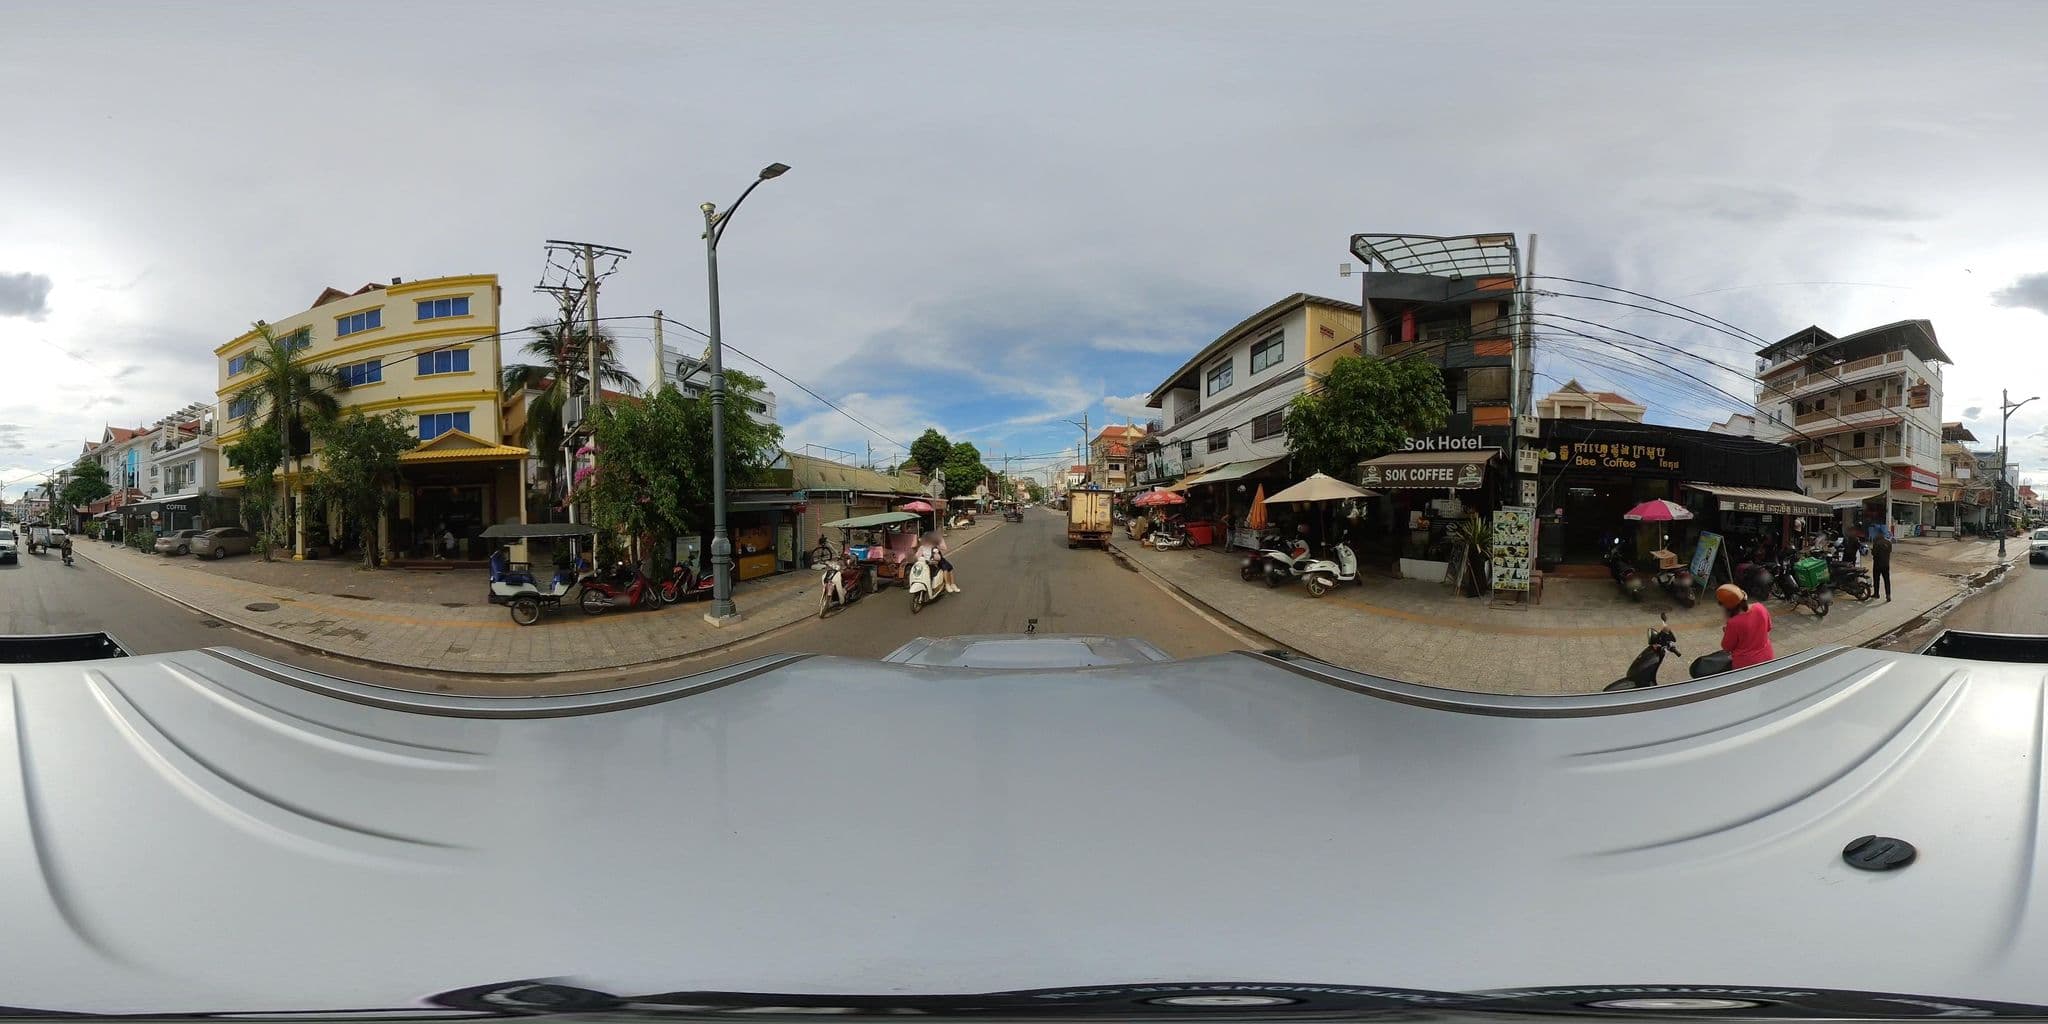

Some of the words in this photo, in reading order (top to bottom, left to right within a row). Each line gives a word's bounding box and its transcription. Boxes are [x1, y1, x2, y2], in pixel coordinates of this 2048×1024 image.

[1405, 437, 1436, 451] Sok
[1438, 435, 1483, 449] Hotel
[1575, 455, 1597, 467] Bee
[1603, 457, 1637, 468] Coffee
[1385, 469, 1408, 481] SOK
[1410, 468, 1454, 481] COFFEE
